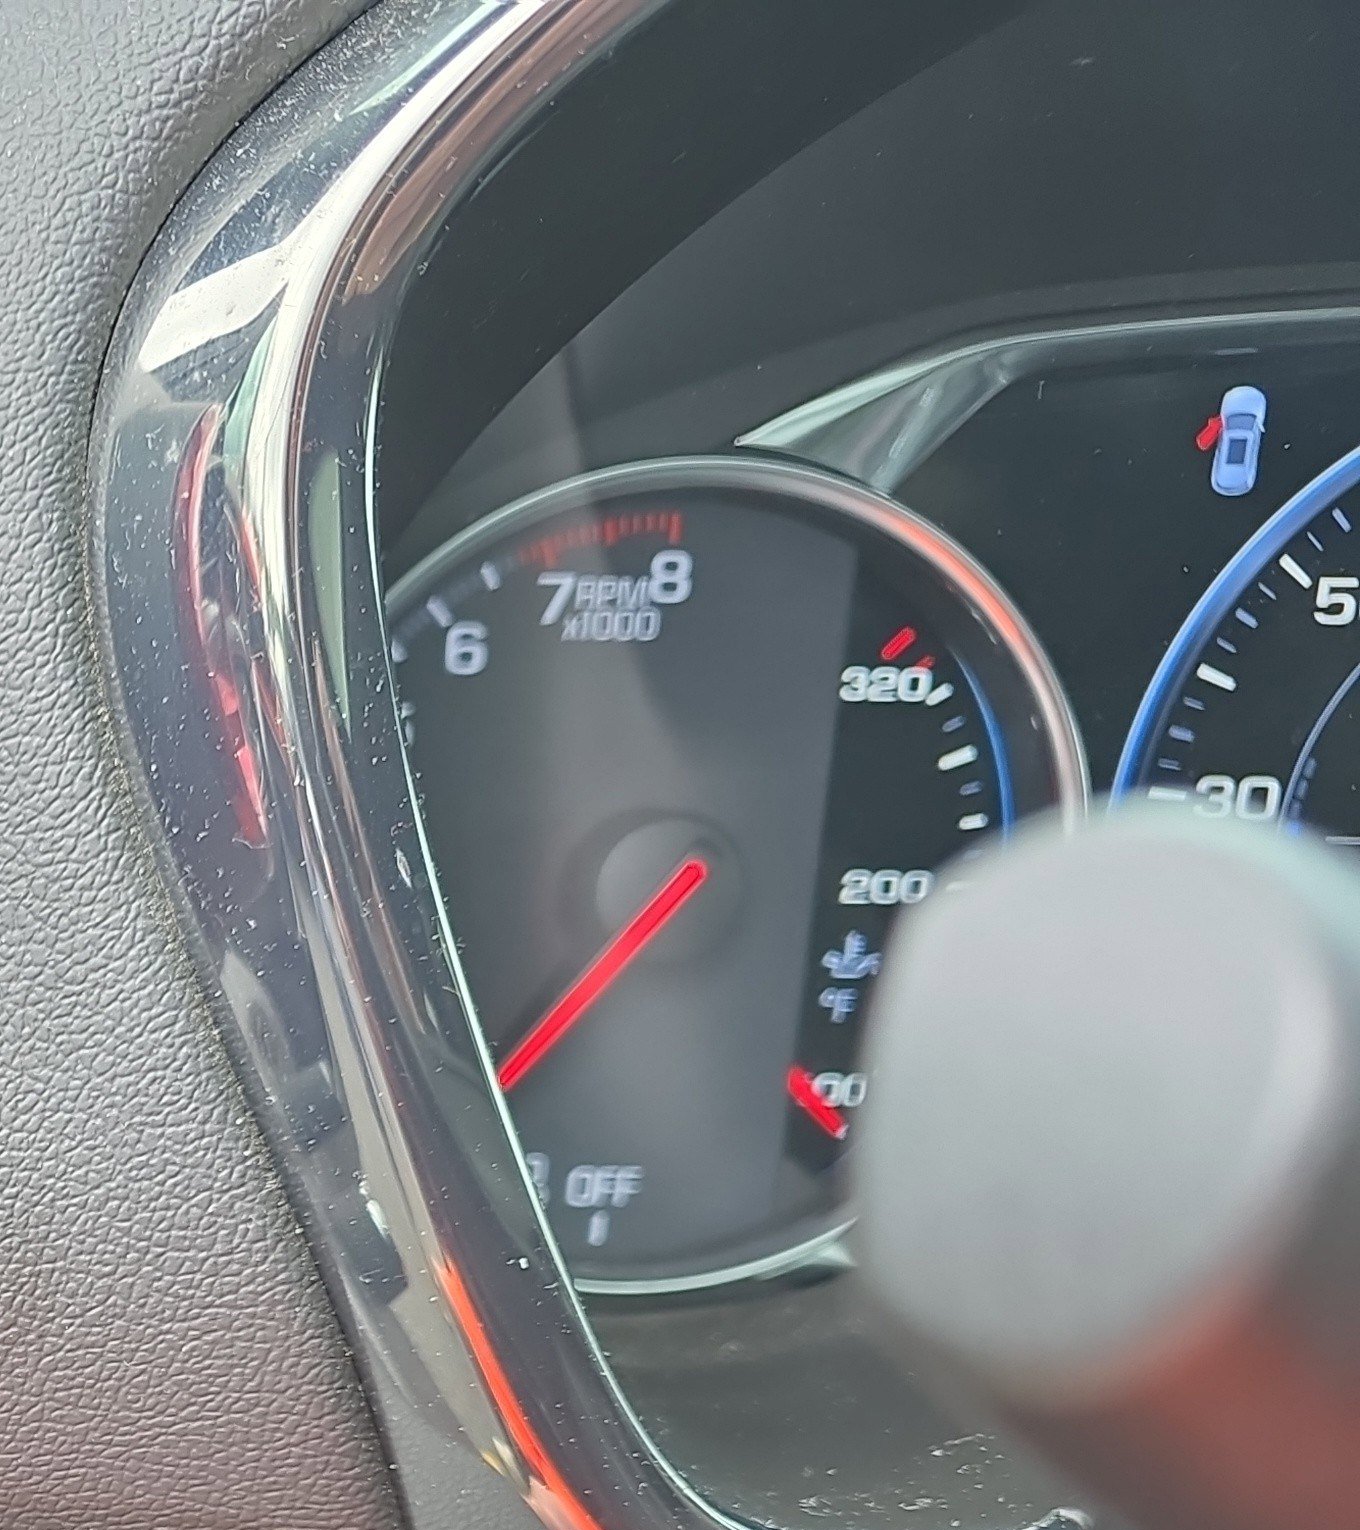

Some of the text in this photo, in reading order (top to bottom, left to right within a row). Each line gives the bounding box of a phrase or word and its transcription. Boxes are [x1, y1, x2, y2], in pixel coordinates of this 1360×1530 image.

[536, 571, 578, 626] 7
[576, 574, 651, 611] RPM
[646, 550, 693, 604] 8
[1313, 576, 1360, 626] 5
[444, 620, 489, 676] 6
[839, 665, 933, 702] 320
[1193, 774, 1281, 820] 30
[838, 868, 935, 905] 200
[565, 1164, 644, 1208] OFF
